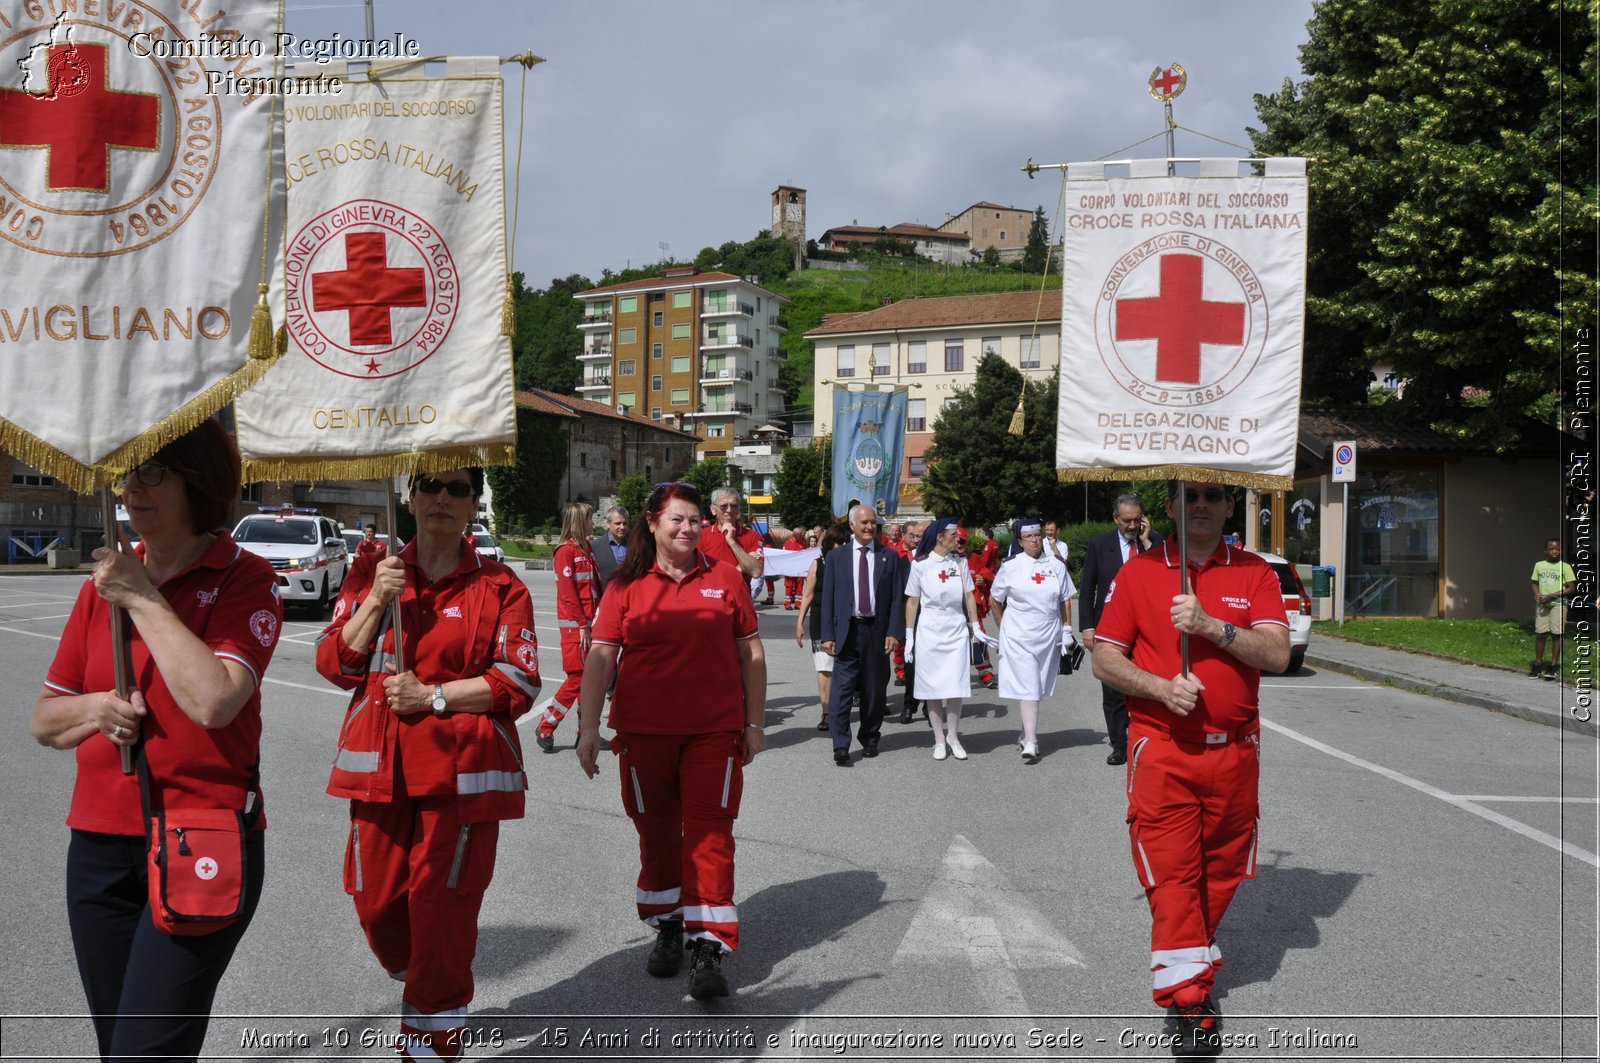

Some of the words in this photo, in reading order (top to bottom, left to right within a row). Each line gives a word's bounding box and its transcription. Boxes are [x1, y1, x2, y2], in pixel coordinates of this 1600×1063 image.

[166, 56, 200, 89] 22
[297, 102, 371, 121] VOLONTARI
[374, 102, 400, 117] DEL
[402, 99, 476, 117] SOCCORSO
[171, 97, 212, 199] AGOSTO
[317, 139, 390, 170] ROSSA
[395, 144, 479, 202] ITALIANA
[1080, 193, 1116, 210] CORPO
[1123, 191, 1191, 208] VOLONTARI
[1197, 193, 1221, 209] DEL
[1228, 192, 1289, 208] SOCCORSO
[108, 196, 178, 244] 1864
[311, 221, 331, 241] DI
[331, 205, 406, 230] GINEVRA
[1068, 213, 1133, 230] CROCE
[1141, 211, 1206, 229] ROSSA
[1214, 213, 1301, 230] ITALIANA
[408, 222, 432, 244] 22
[425, 243, 454, 315] AGOSTO
[1101, 234, 1190, 302] CONVENZIONE
[1197, 238, 1212, 251] DI
[1215, 248, 1263, 304] GINEVRA
[286, 235, 328, 357] CONVENZIONE
[0, 304, 231, 343] VIGLIANO
[416, 318, 446, 352] 1864
[312, 403, 437, 430] CENTALLO
[1097, 412, 1230, 432] DELEGAZIONE
[1240, 418, 1259, 433] DI
[1103, 432, 1250, 456] PEVERAGNO
